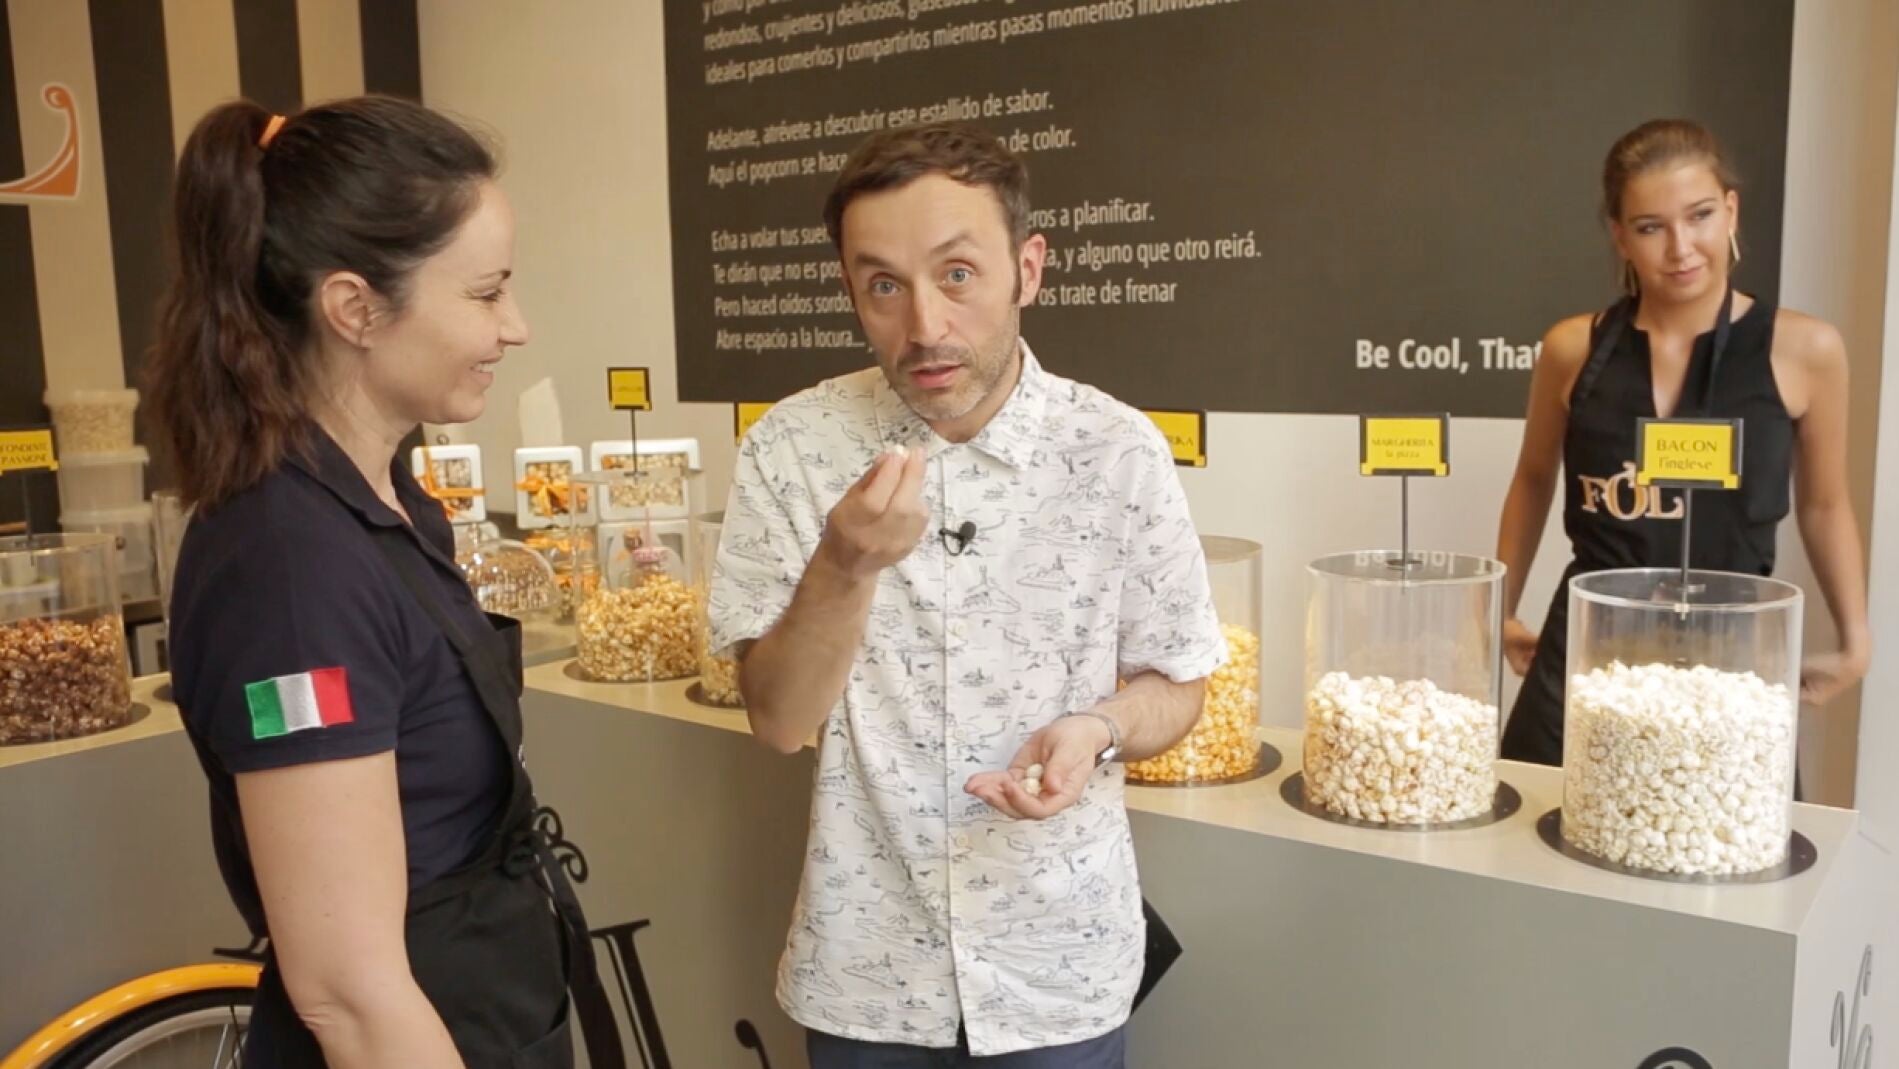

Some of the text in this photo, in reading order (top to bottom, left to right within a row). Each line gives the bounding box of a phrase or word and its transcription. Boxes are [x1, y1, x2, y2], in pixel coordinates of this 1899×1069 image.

[704, 23, 762, 50] redondos,
[764, 13, 825, 42] crujientes
[826, 12, 835, 35] y
[836, 1, 905, 27] deliciosos,
[705, 61, 746, 84] ideales
[748, 57, 775, 83] para
[777, 45, 834, 73] comerlos
[835, 47, 844, 69] y
[846, 30, 930, 62] compartirlos
[933, 23, 996, 47] mientras
[1000, 12, 1044, 43] pasas
[1047, 0, 1134, 29] momentos
[707, 87, 1053, 151] Adelante, atrévete a descubrir este estallido de sabor.
[708, 160, 735, 189] Aquí
[737, 160, 748, 182] el
[751, 157, 800, 185] popcorn
[802, 156, 815, 176] se
[1010, 128, 1029, 153] de
[1032, 124, 1077, 151] color.
[711, 229, 738, 252] Echa
[740, 232, 748, 250] a
[750, 225, 777, 249] volar
[780, 227, 799, 246] tus
[1060, 208, 1070, 227] a
[1073, 198, 1155, 232] planificar.
[713, 264, 726, 284] Te
[728, 260, 757, 283] dirán
[759, 264, 782, 287] que
[785, 263, 801, 280] no
[804, 261, 817, 279] es
[1064, 247, 1076, 273] y
[1077, 240, 1132, 272] alguno
[1136, 242, 1170, 269] que
[1174, 238, 1210, 260] otro
[1214, 230, 1262, 259] reirá.
[715, 278, 1178, 317] Pero haced oídos sordo os trate de frenar
[716, 329, 742, 350] Abre
[744, 328, 788, 354] espacio
[790, 331, 798, 347] a
[800, 326, 813, 347] la
[1356, 339, 1390, 368] Be
[1399, 337, 1469, 374] Cool,
[1656, 439, 1717, 452] BACON
